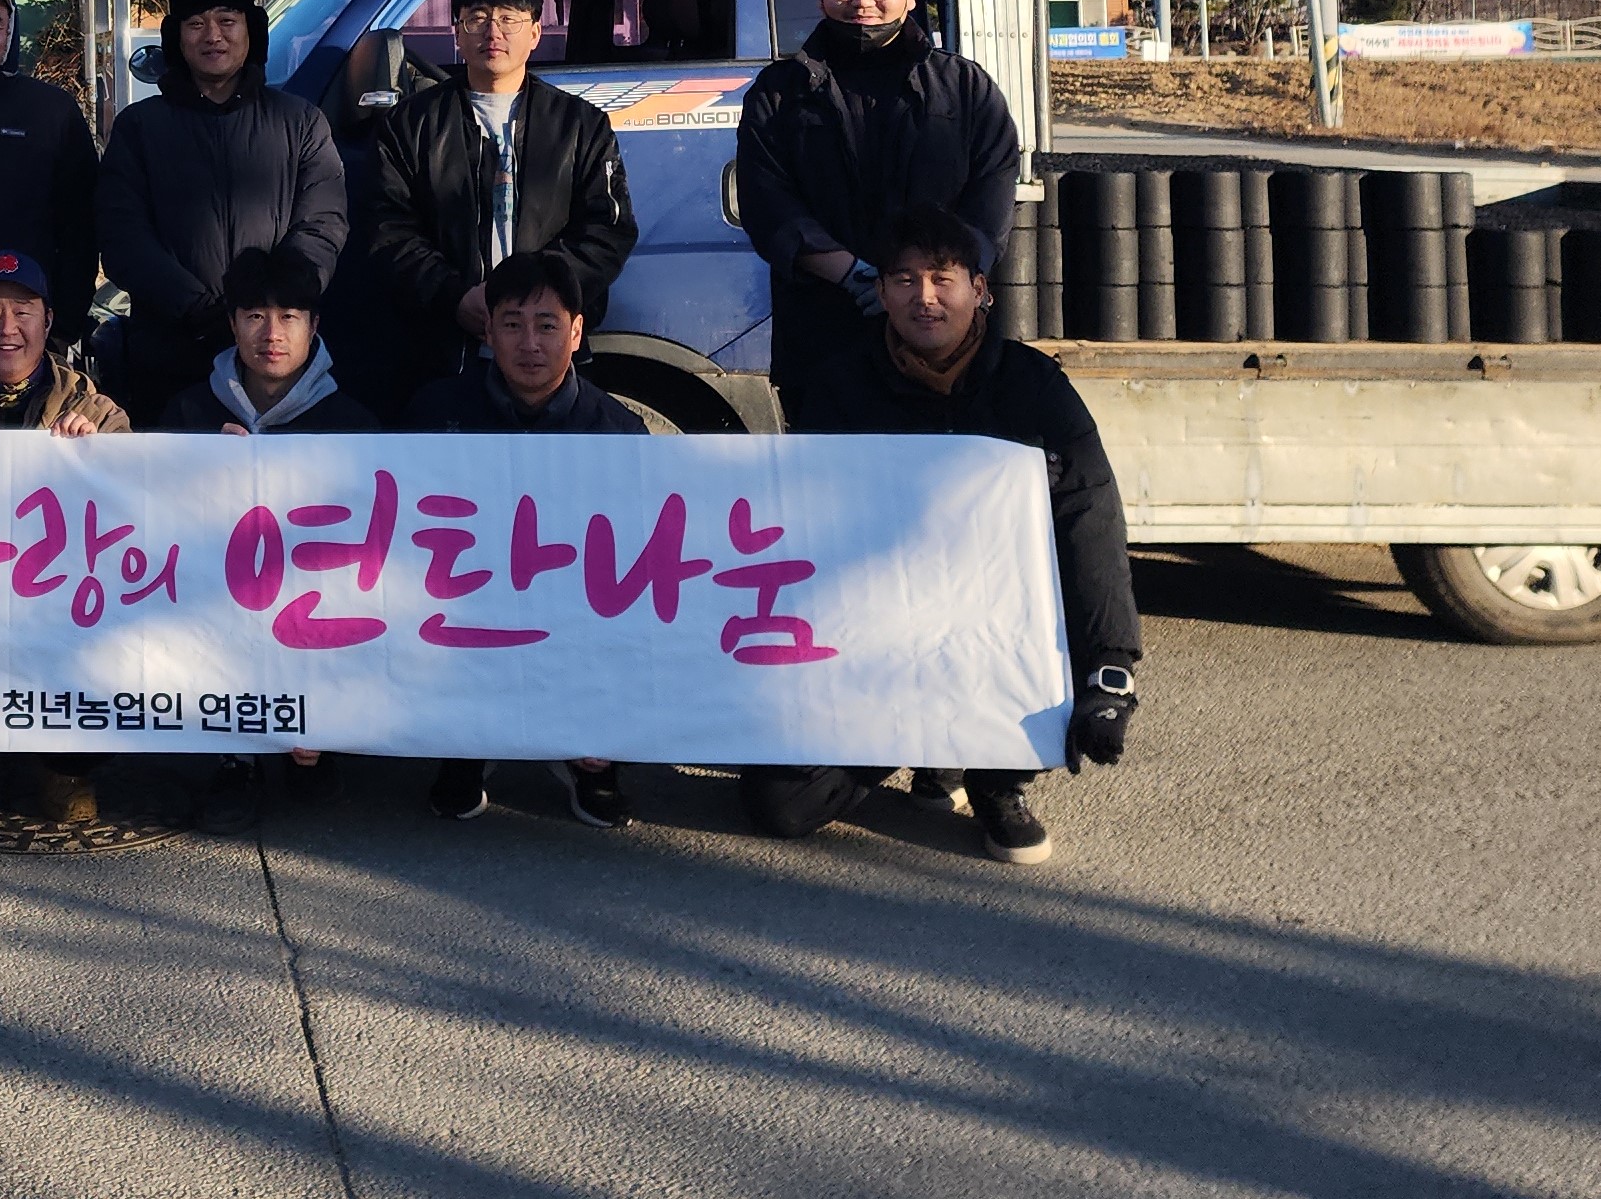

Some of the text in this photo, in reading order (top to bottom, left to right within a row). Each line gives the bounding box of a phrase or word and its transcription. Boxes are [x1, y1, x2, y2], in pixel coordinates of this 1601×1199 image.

[656, 111, 730, 126] BONGO
[225, 469, 840, 667] 연탄나눔
[2, 689, 185, 731] 청년농업인
[199, 691, 307, 736] 연합회
